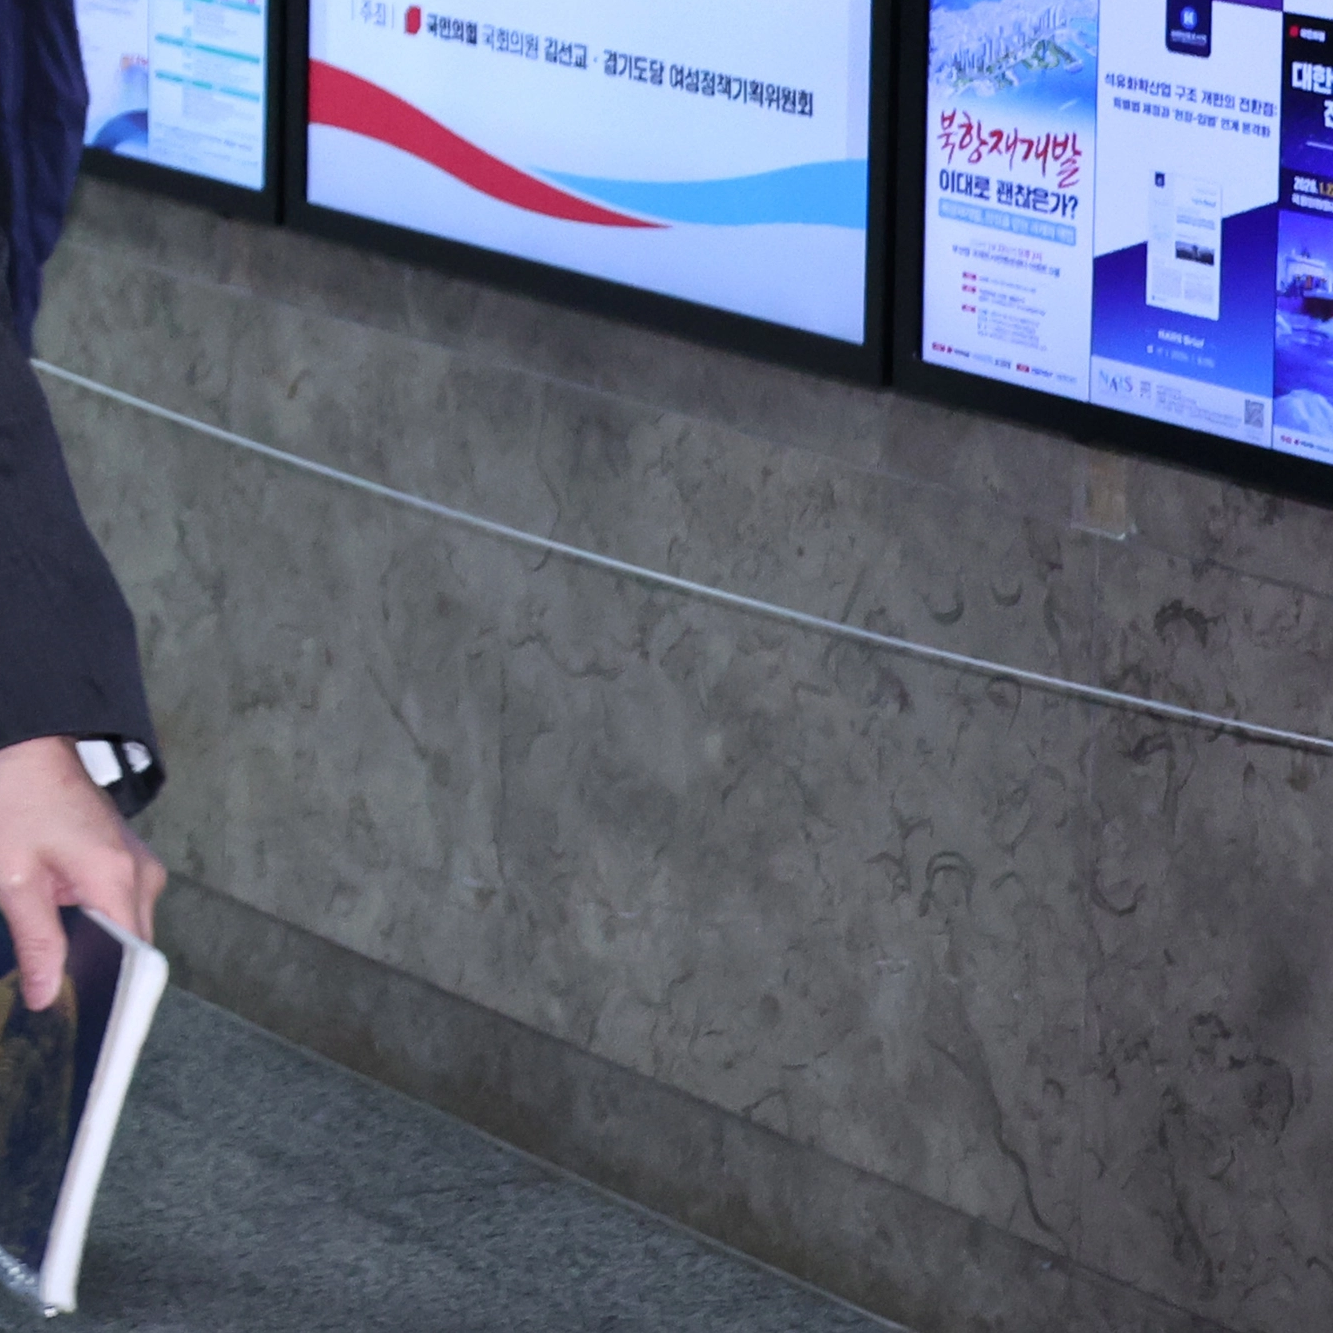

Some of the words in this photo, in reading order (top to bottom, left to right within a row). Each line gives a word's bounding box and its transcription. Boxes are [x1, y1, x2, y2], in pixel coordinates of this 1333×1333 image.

[426, 12, 478, 45] 국민의힘
[482, 22, 539, 60] 국회의원
[544, 36, 588, 69] 김선교
[603, 48, 664, 87] 경기도당
[669, 63, 814, 118] 여성정책기획위원회
[1175, 84, 1198, 103] 구조
[937, 107, 1083, 190] 북항재개발
[938, 168, 991, 202] 이대로
[996, 179, 1079, 220] 괜찮은가?
